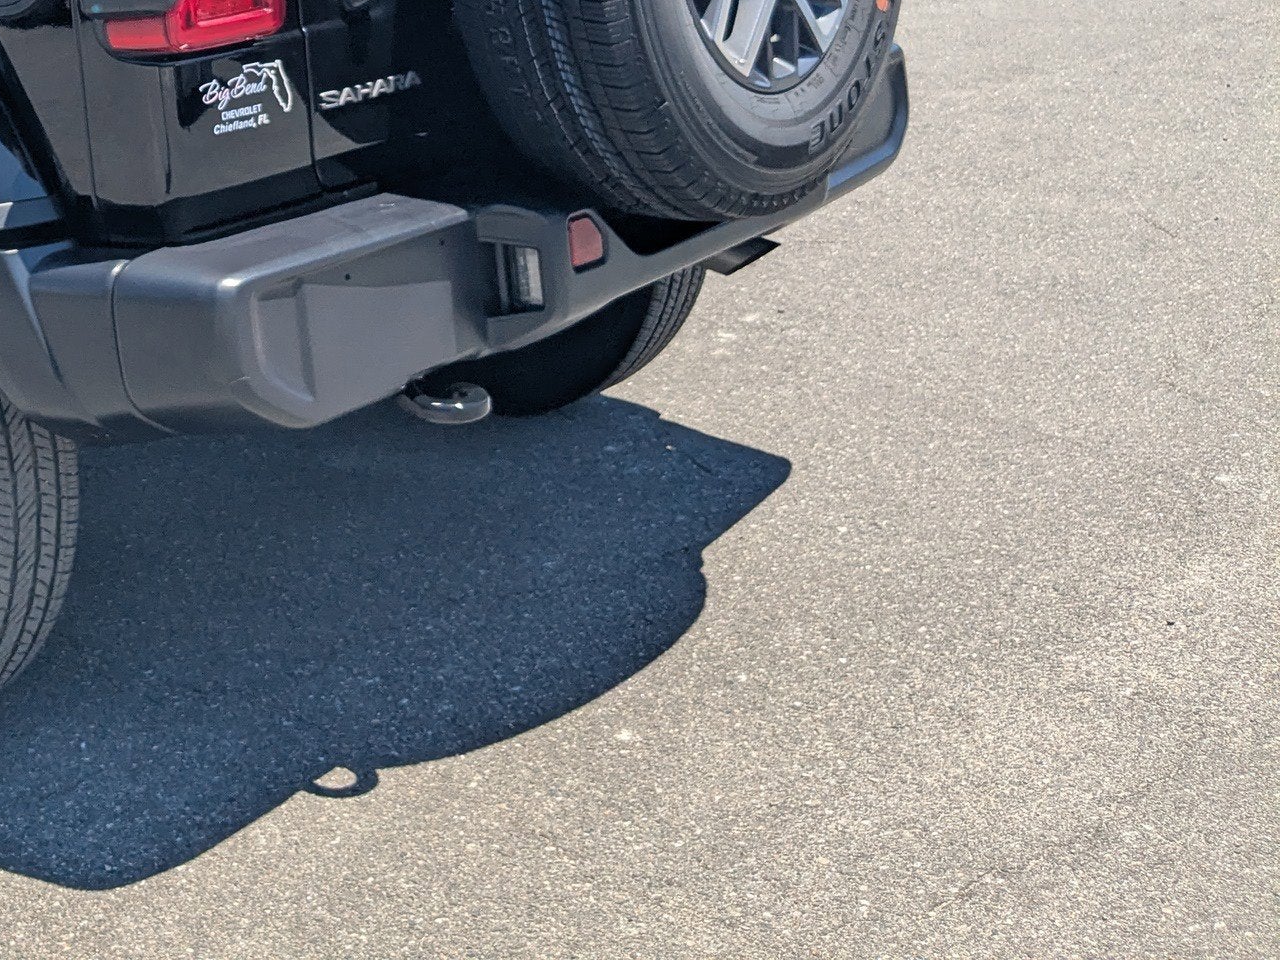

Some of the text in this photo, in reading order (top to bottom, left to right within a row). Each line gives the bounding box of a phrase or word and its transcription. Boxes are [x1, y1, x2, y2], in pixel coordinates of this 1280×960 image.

[199, 73, 268, 110] Big Bend
[320, 70, 420, 110] SAHARA
[213, 113, 270, 135] Chiefland, FL
[221, 103, 262, 121] CHEVROLET
